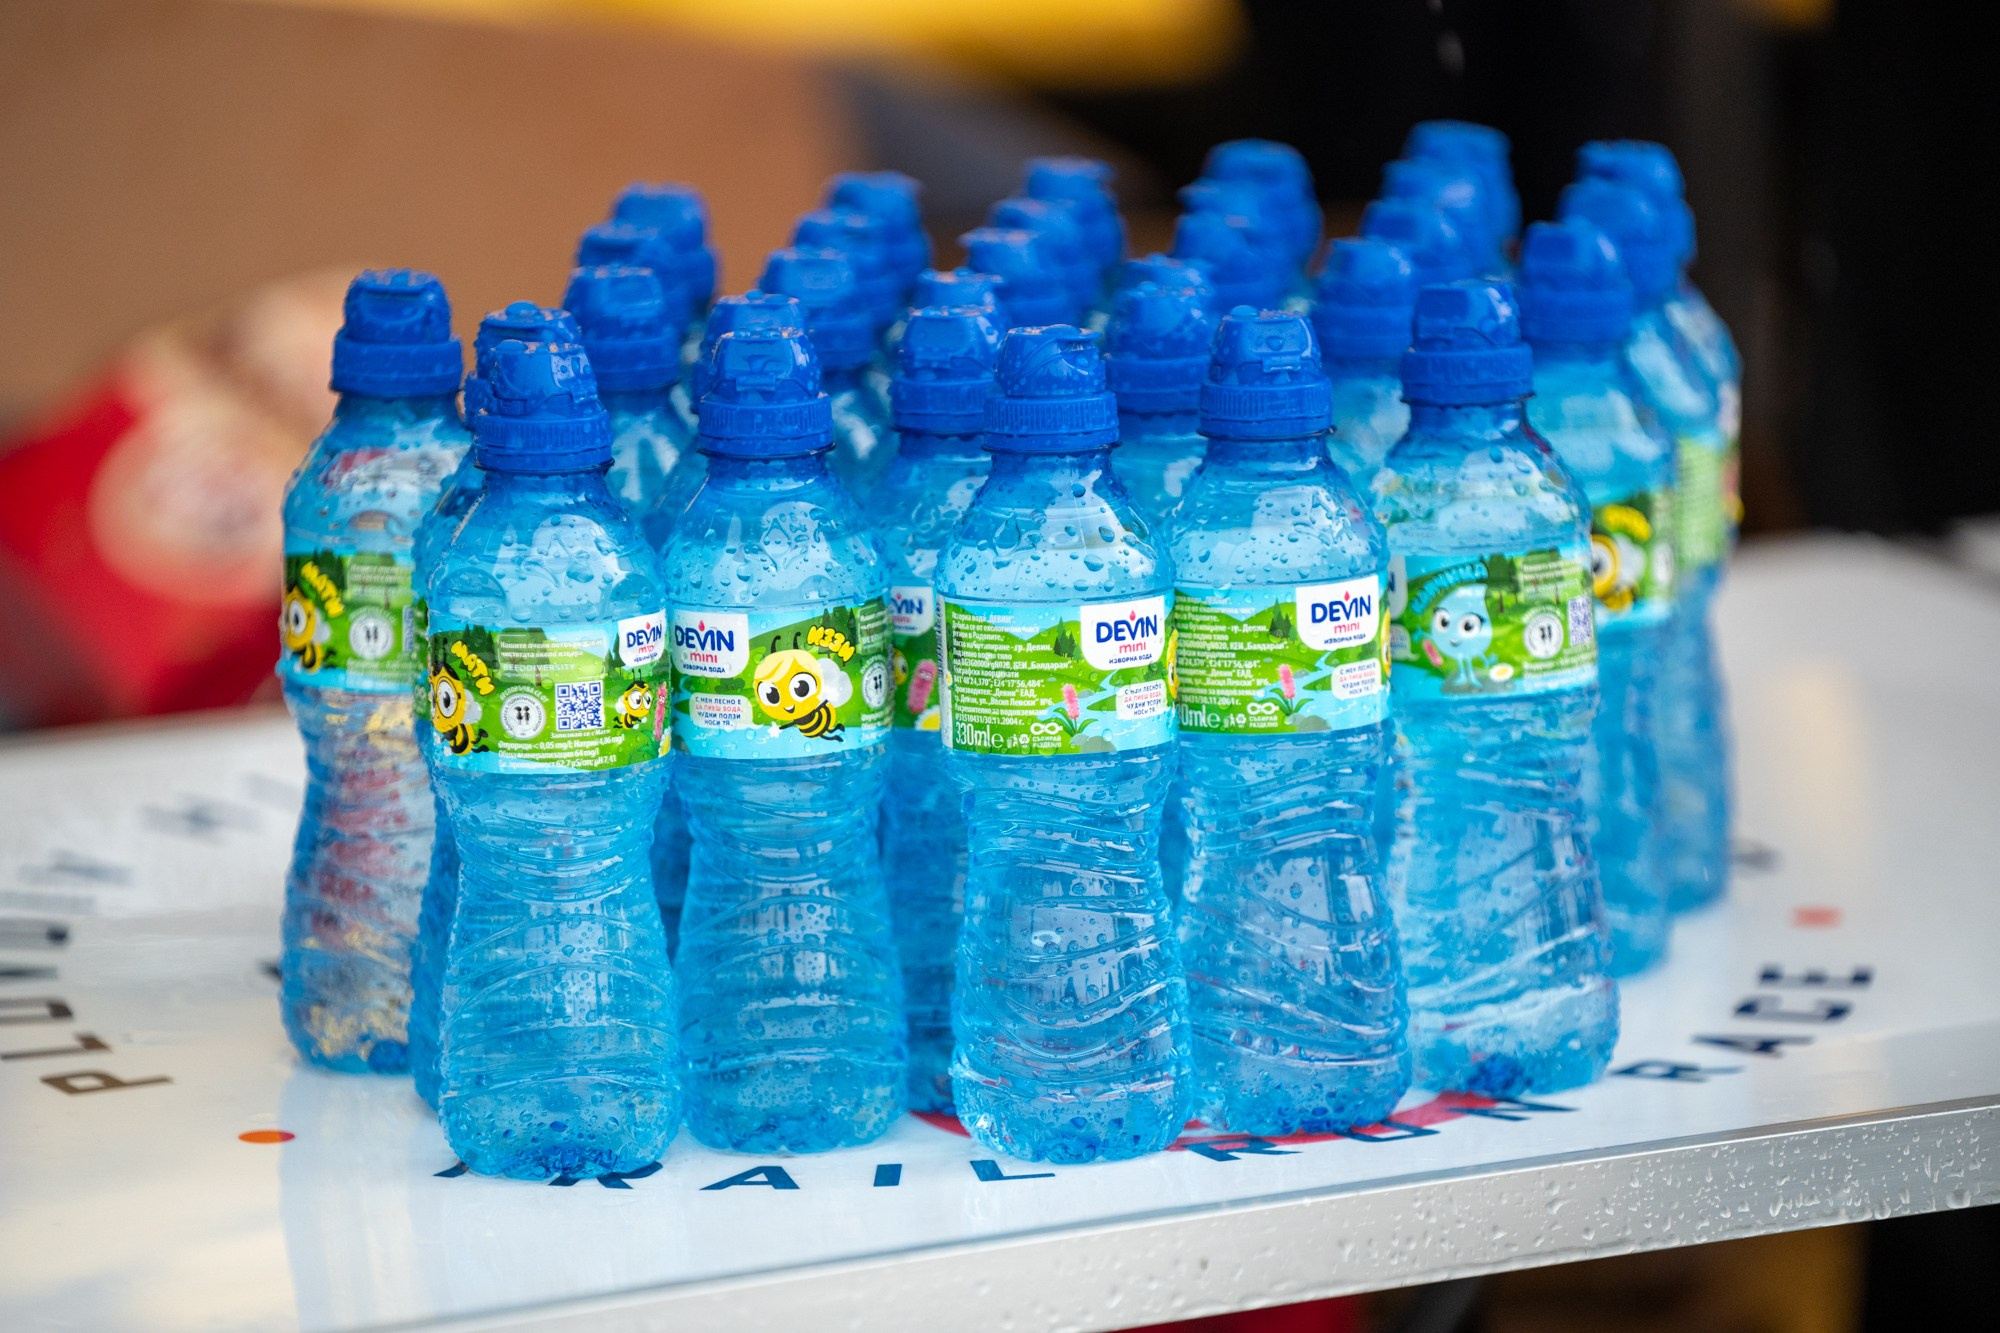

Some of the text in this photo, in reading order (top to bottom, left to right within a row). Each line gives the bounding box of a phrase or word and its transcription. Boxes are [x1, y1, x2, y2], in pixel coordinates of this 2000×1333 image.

[1311, 594, 1371, 624] DEVIN
[626, 624, 662, 648] DEVIN
[675, 625, 734, 652] DEVIN
[1096, 614, 1157, 643] DEVIN
[1334, 622, 1360, 634] mini
[690, 652, 717, 663] mini
[1109, 655, 1138, 664] ИЗВОРНА
[1119, 642, 1146, 653] mini
[450, 639, 496, 696] МАТИ
[503, 663, 575, 671] BEEODIVERSITY
[1608, 966, 1874, 1084] RACE
